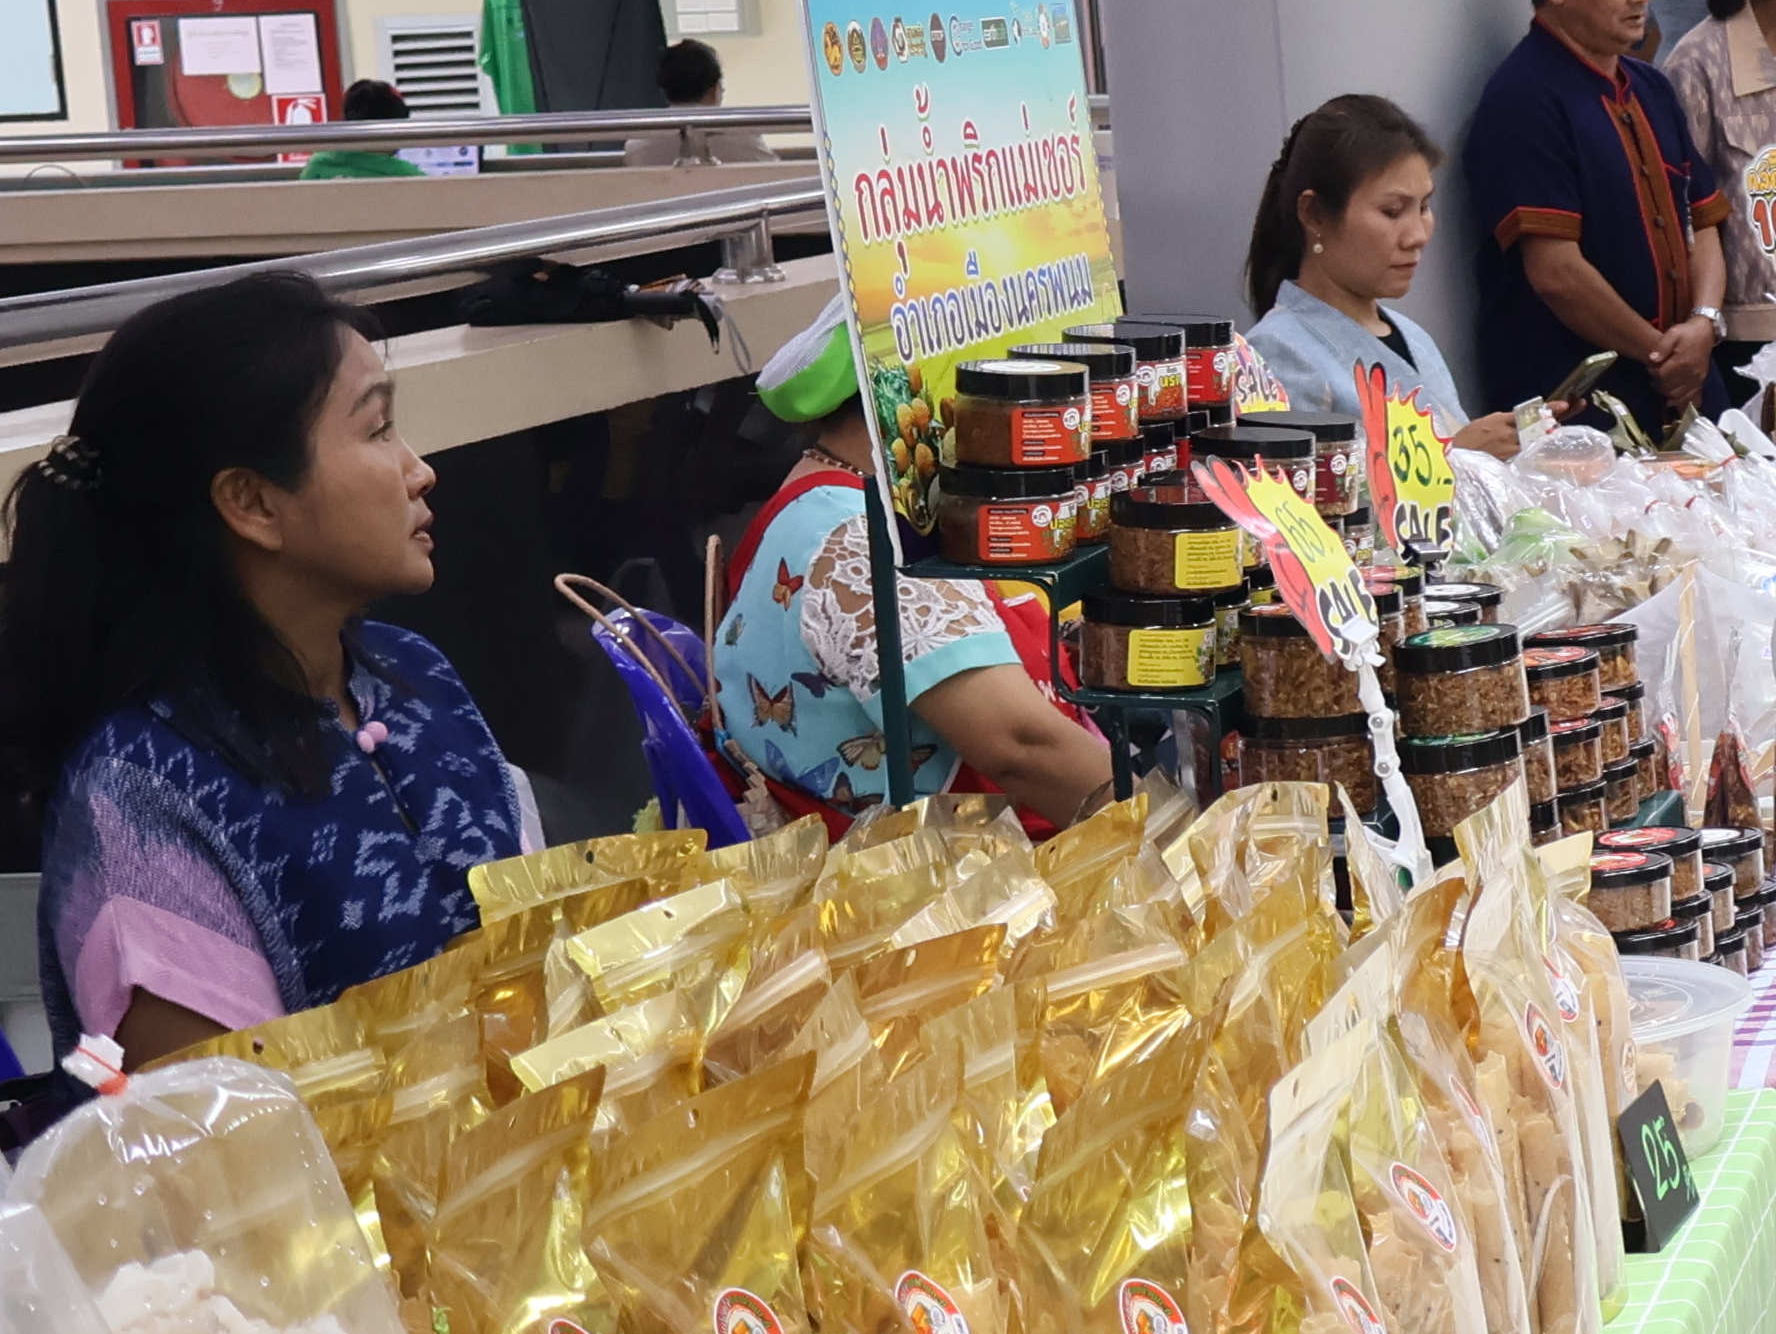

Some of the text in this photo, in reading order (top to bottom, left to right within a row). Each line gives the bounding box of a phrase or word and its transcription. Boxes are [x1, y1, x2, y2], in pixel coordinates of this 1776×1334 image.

[853, 83, 1088, 275] กลุ่มน้ำพริกแม่เชอร์
[890, 249, 1096, 365] อำเภอเมืองนครพนม
[1394, 500, 1453, 565] SALE
